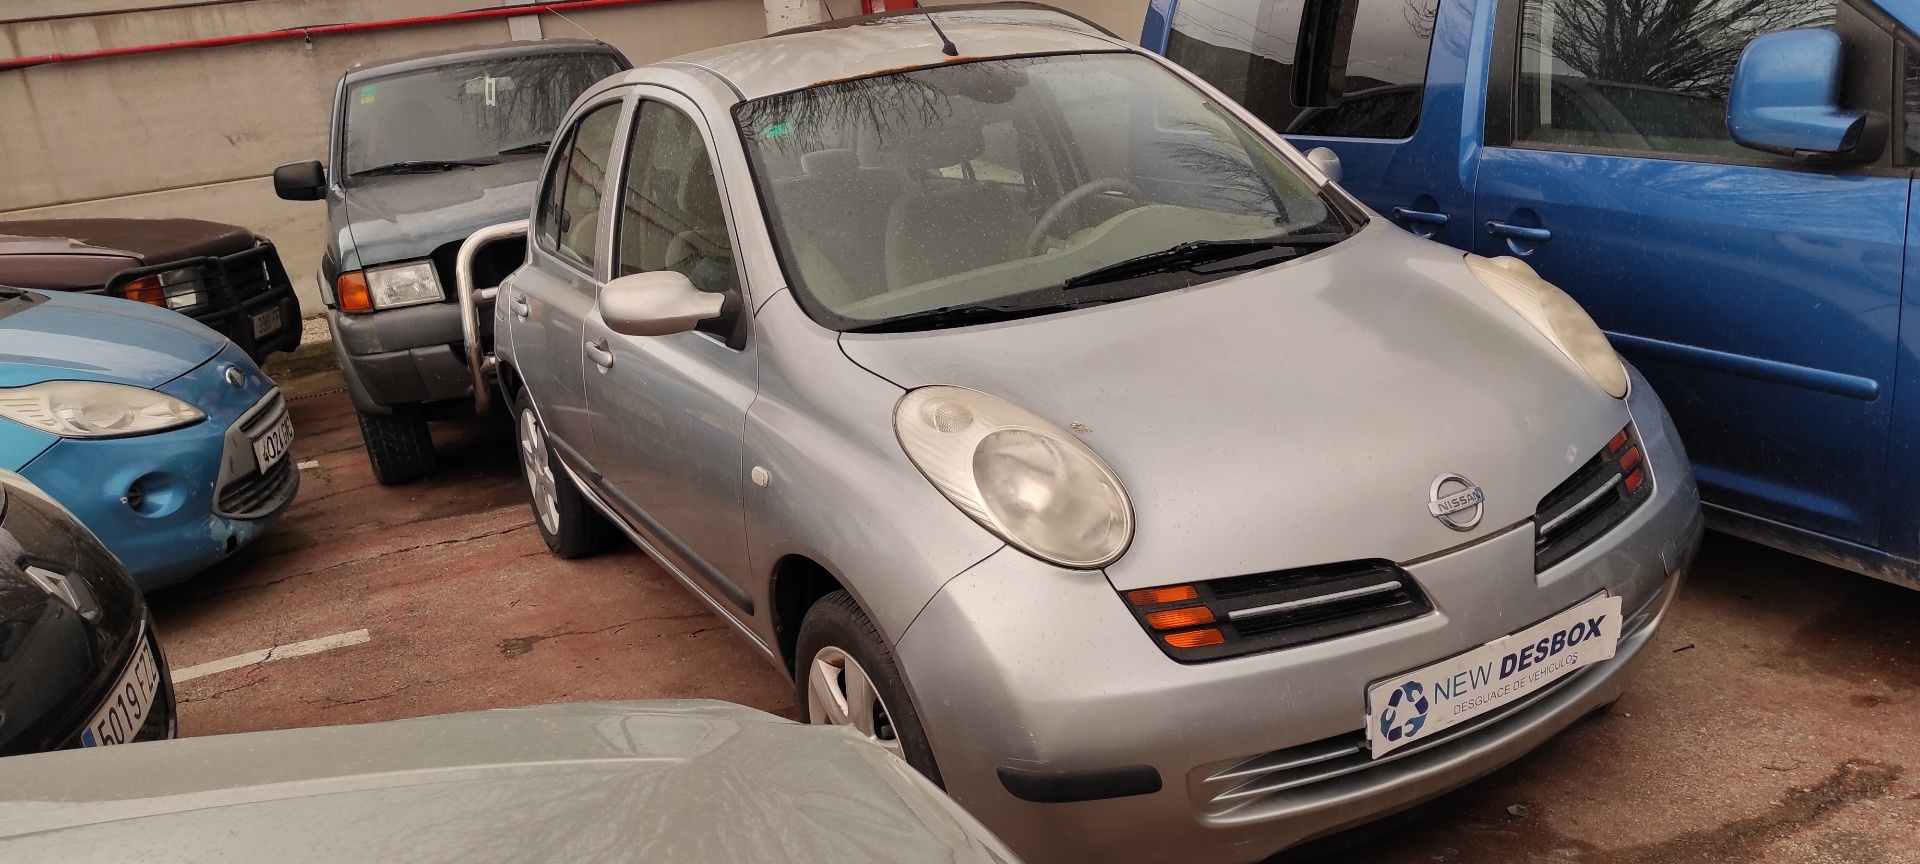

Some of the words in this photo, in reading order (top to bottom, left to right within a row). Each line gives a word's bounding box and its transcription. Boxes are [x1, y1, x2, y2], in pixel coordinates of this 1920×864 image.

[1438, 491, 1483, 512] NISSAN
[1434, 662, 1492, 704] NEW
[1499, 614, 1606, 680] DESBOX
[98, 682, 142, 746] 5019
[135, 643, 157, 704] FZZ
[1453, 685, 1511, 715] DESGUACE
[1513, 678, 1526, 691] DE
